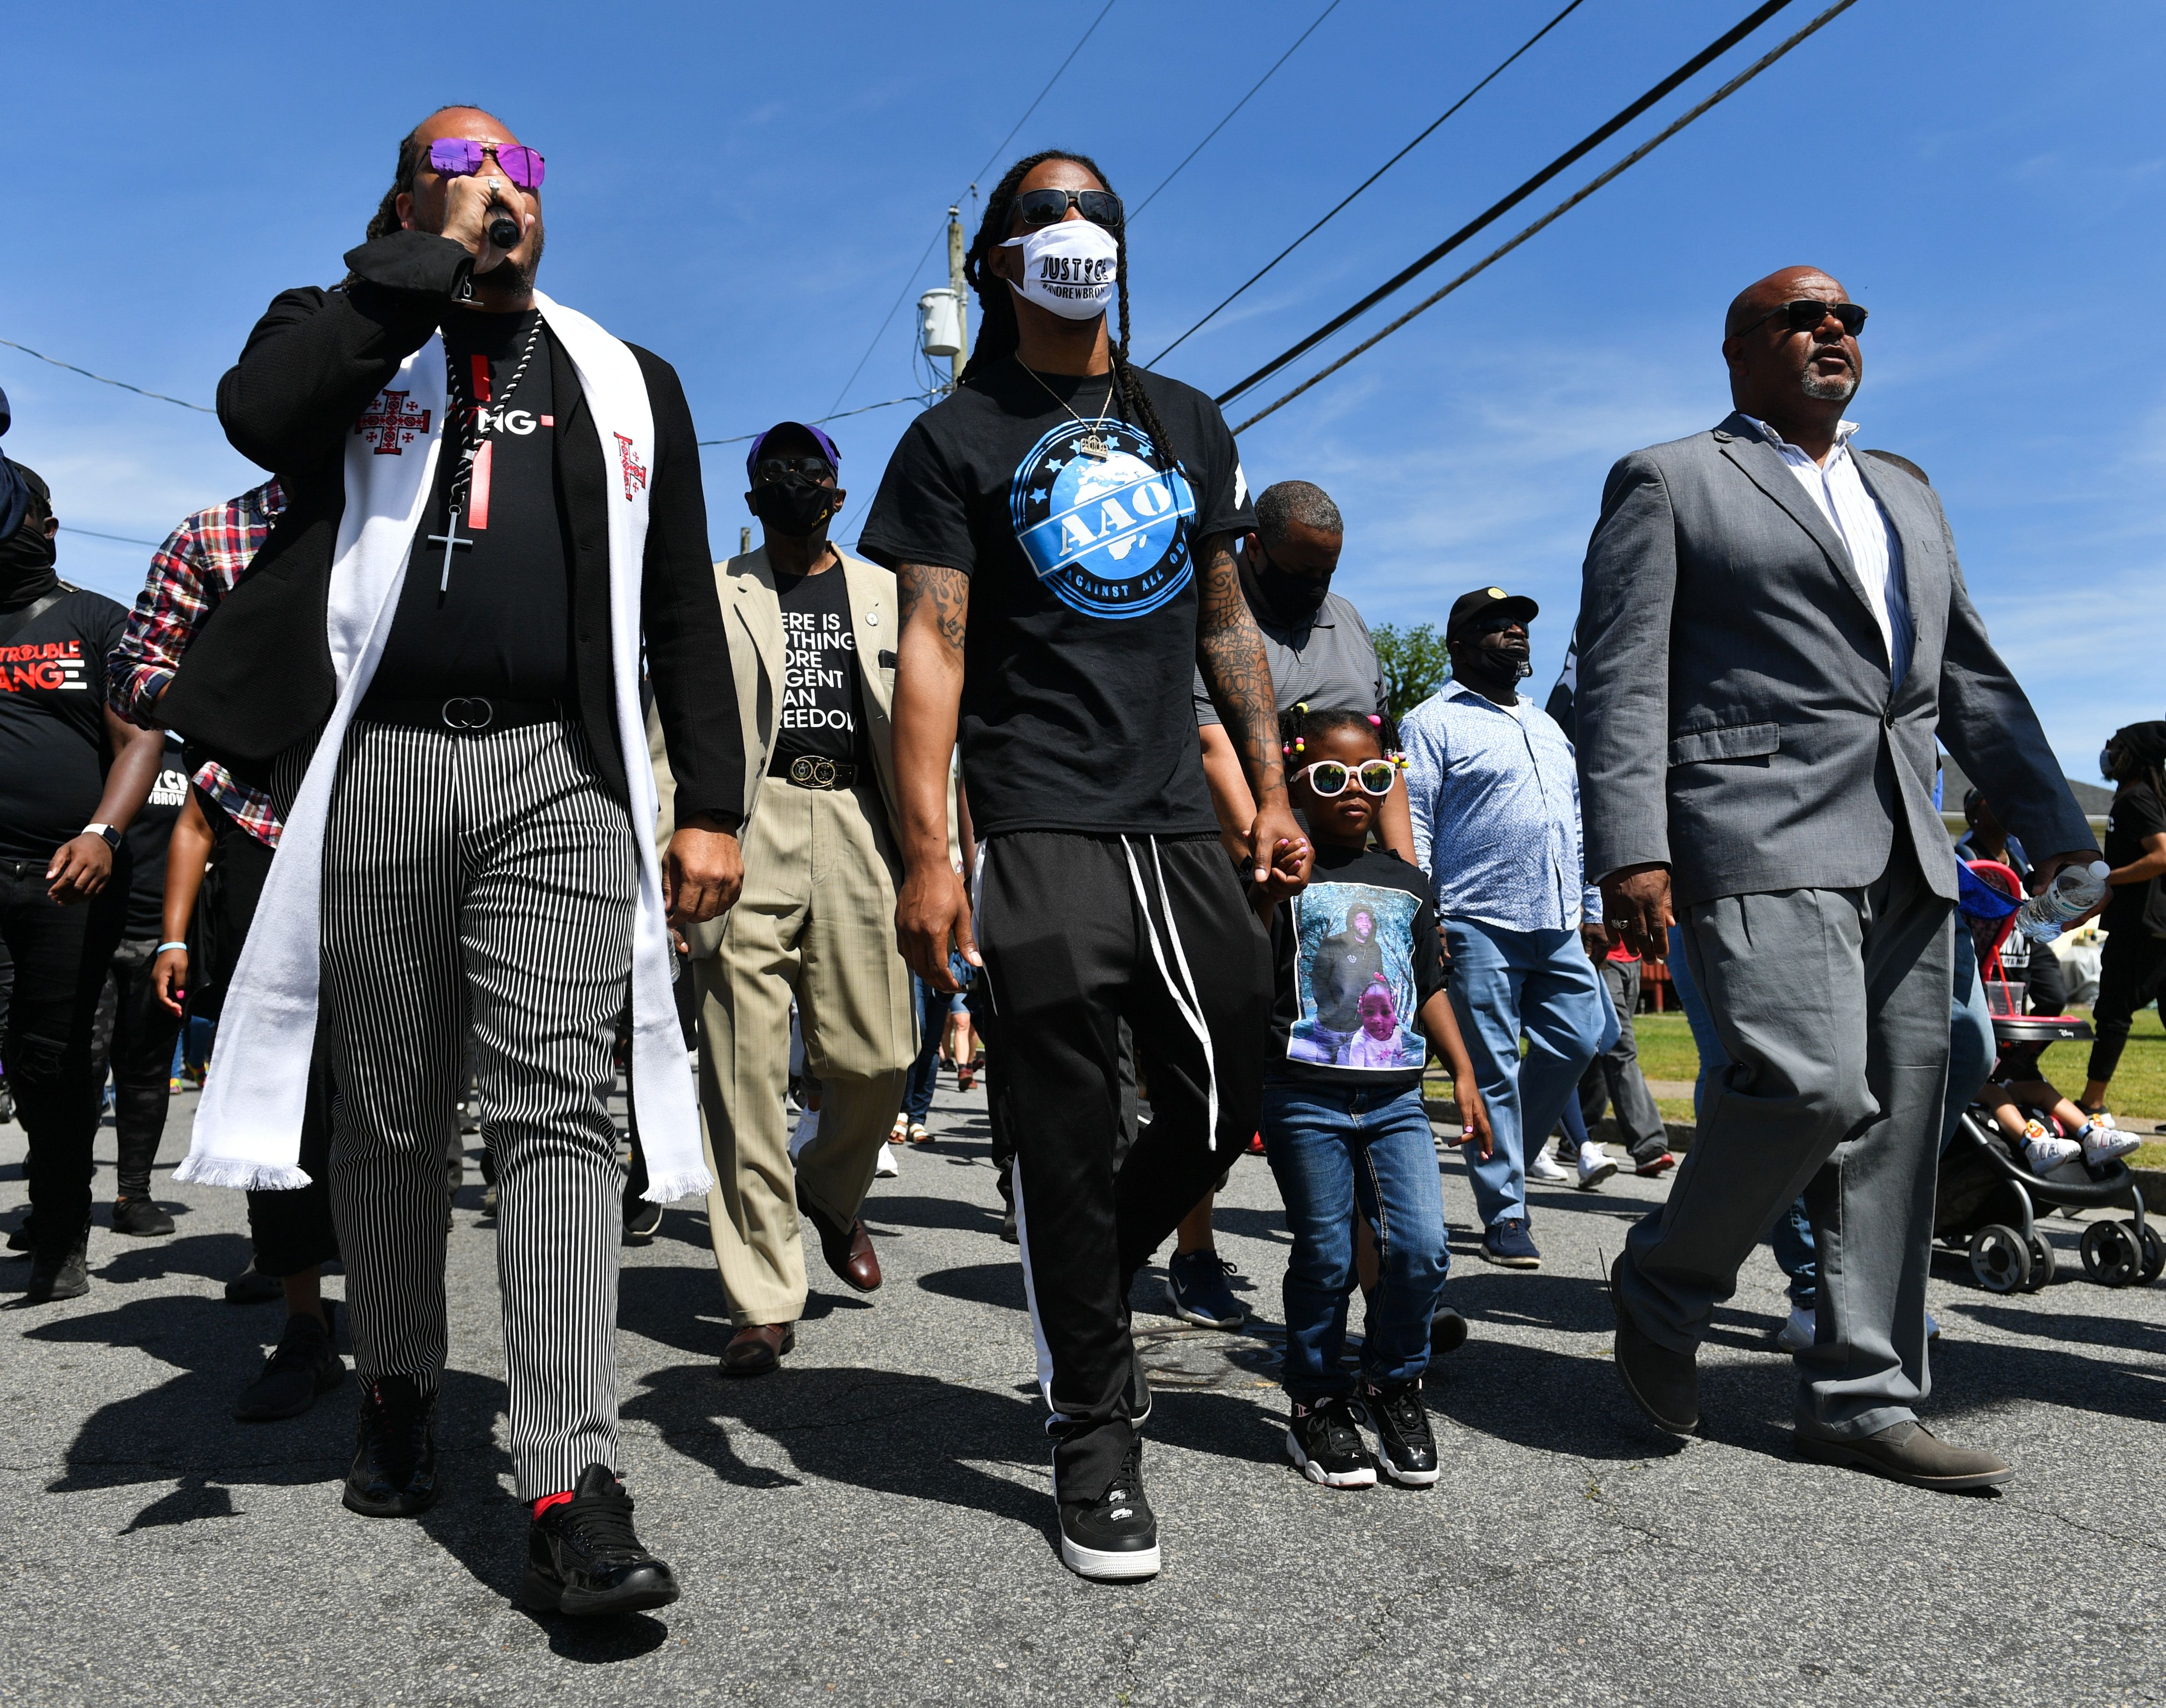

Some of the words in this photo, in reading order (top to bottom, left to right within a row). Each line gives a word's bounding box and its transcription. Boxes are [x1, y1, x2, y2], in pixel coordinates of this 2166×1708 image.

[1059, 482, 1171, 556] AAO
[1065, 569, 1128, 597] AGAINST
[1142, 569, 1163, 591] ALL
[1169, 528, 1186, 564] OD
[823, 613, 840, 630] IS
[785, 668, 844, 689] GENT
[783, 689, 816, 708] AN
[779, 709, 857, 734] EEDOM
